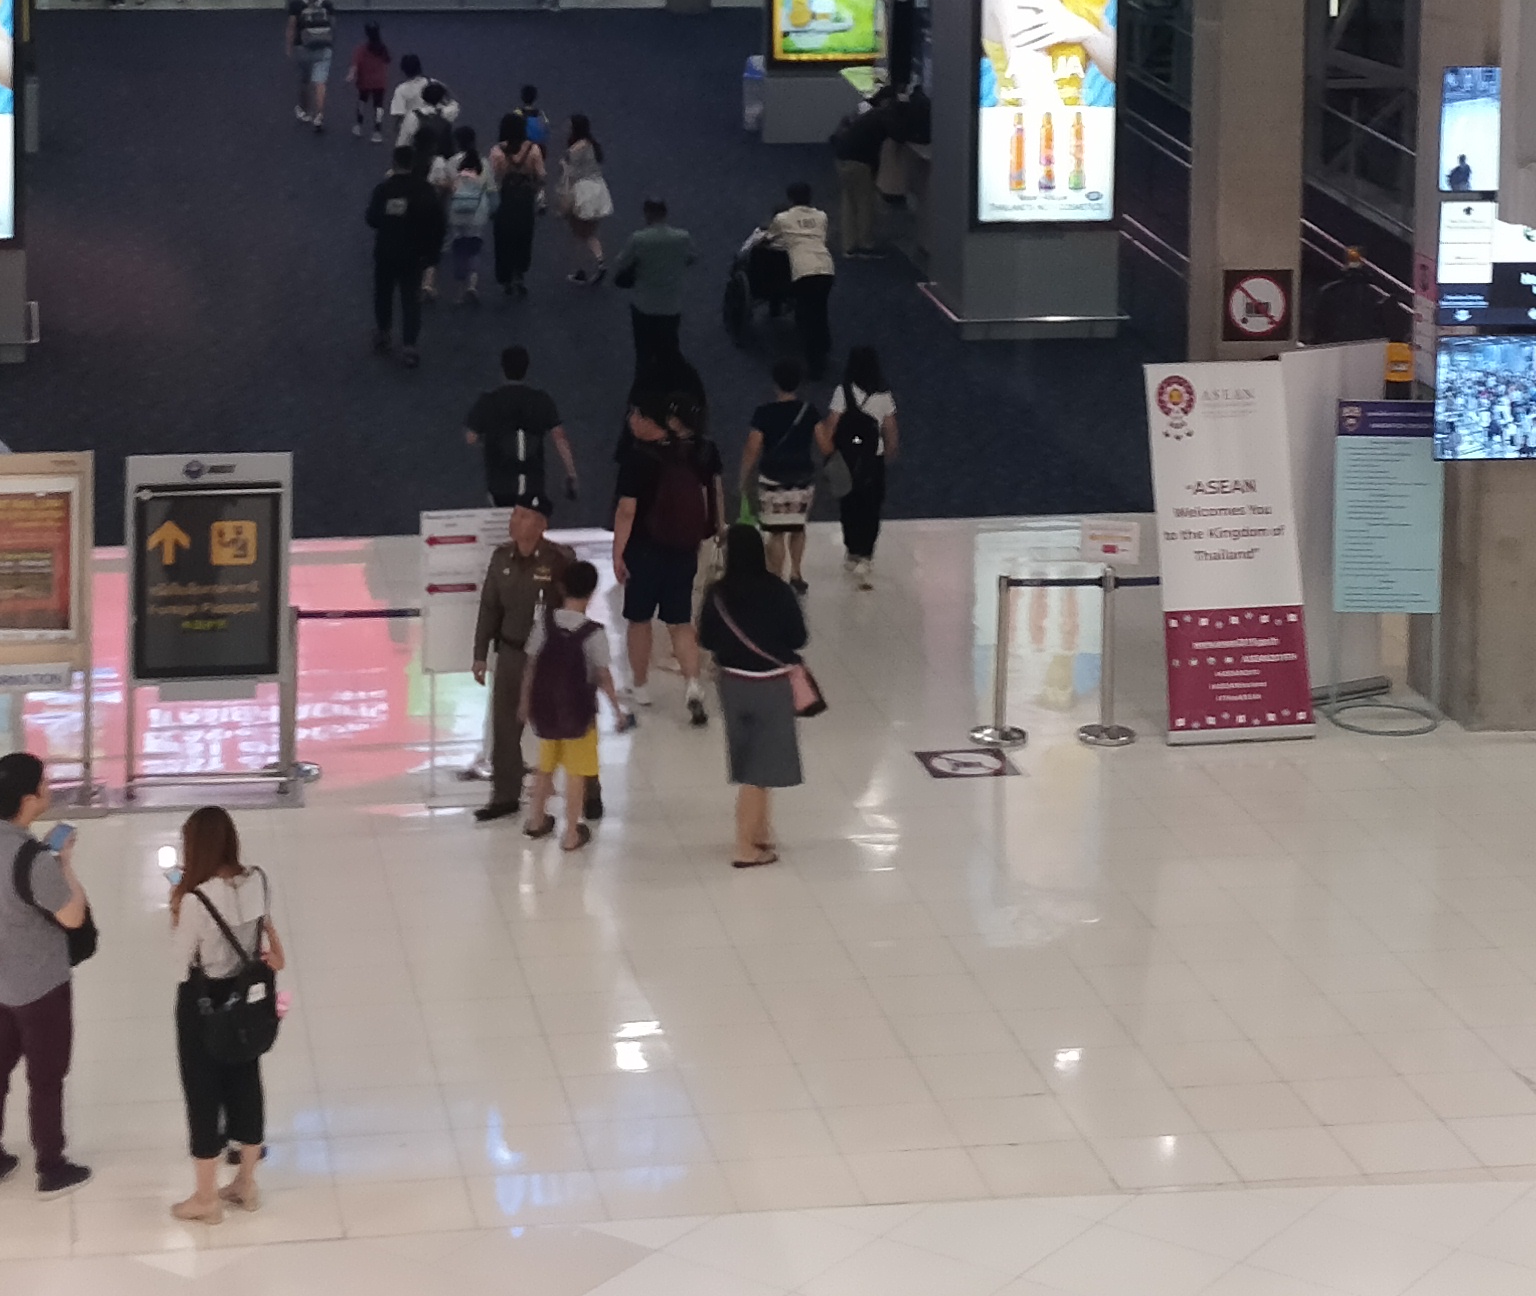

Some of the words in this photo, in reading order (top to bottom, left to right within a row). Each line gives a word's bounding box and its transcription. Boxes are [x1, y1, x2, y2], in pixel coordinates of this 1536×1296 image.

[1173, 505, 1246, 519] Welcomes
[1248, 504, 1272, 517] You
[1180, 529, 1205, 542] the
[1208, 527, 1267, 542] Kingdom
